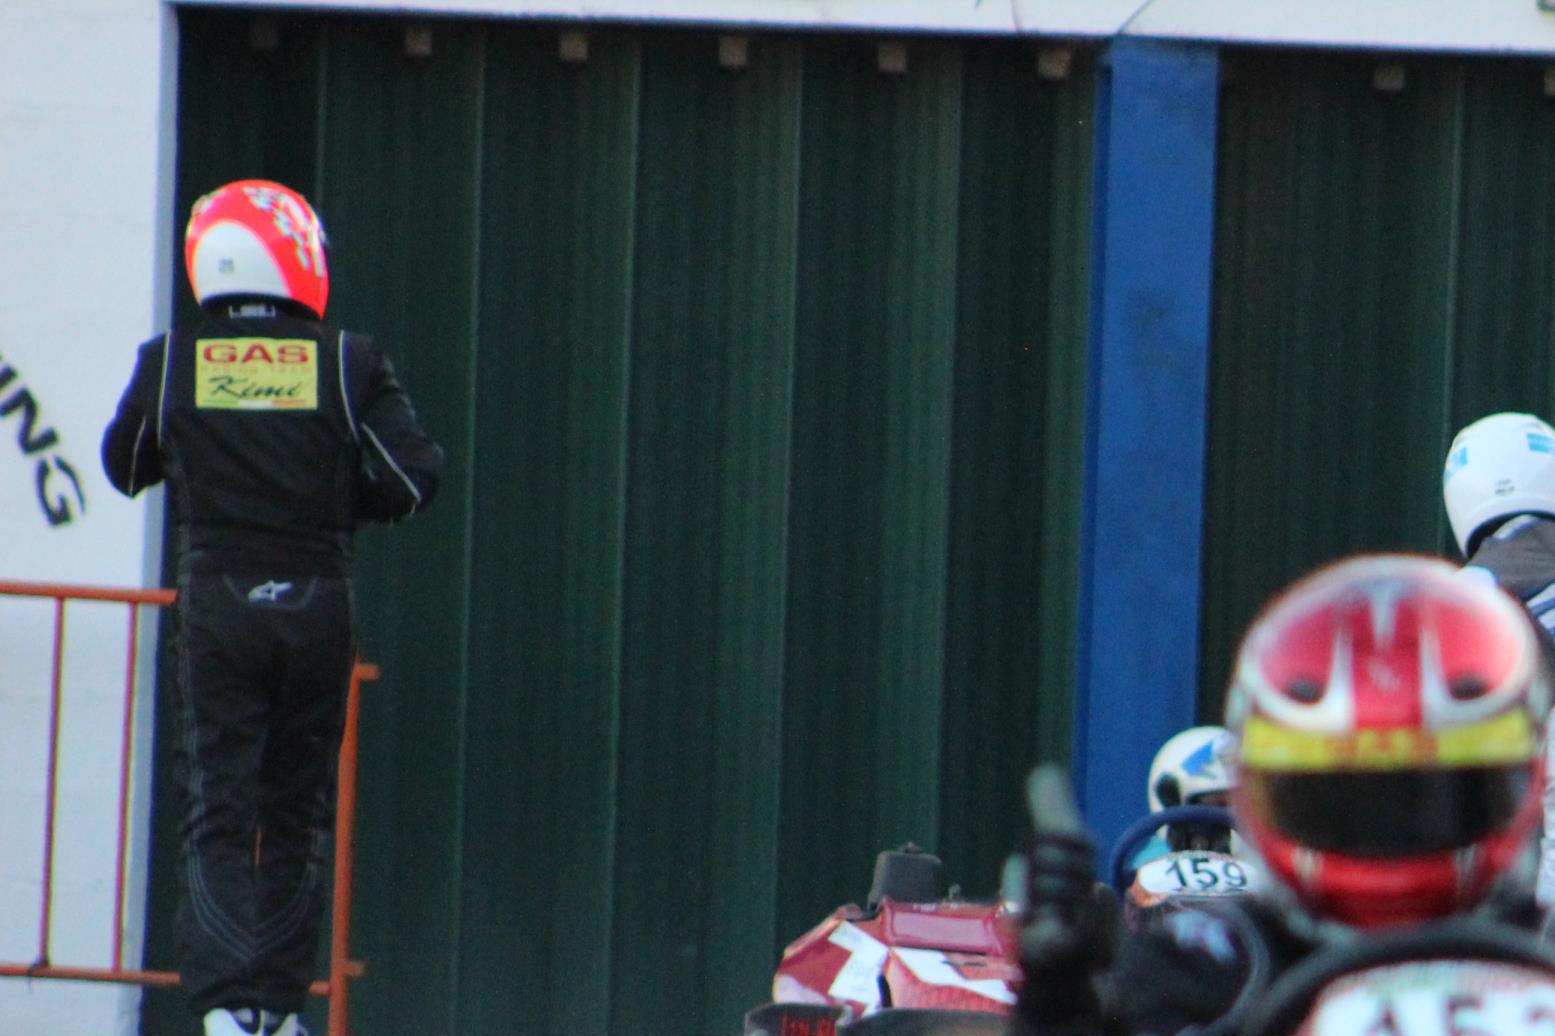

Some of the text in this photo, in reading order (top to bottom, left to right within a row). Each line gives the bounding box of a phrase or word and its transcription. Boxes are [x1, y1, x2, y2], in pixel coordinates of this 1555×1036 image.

[203, 343, 309, 364] GAS
[208, 375, 303, 399] Kimi
[1165, 858, 1248, 891] 159
